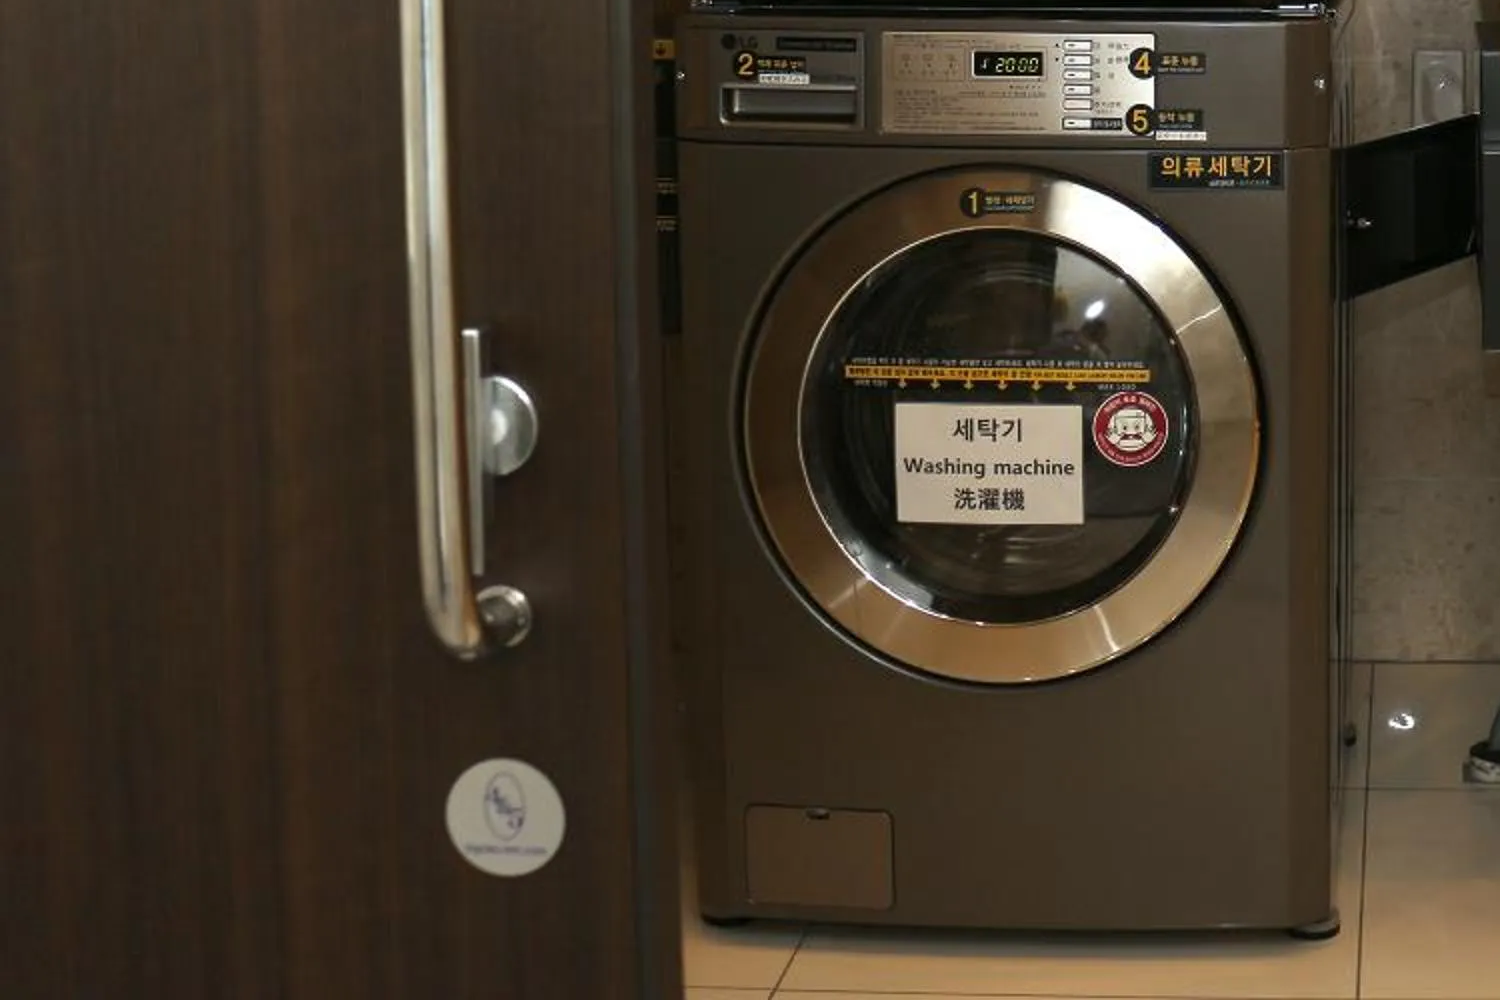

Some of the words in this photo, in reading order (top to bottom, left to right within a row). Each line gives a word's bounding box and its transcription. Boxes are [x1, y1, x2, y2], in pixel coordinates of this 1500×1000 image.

[738, 53, 754, 75] 2
[1134, 52, 1151, 74] 4
[1132, 110, 1148, 132] 5
[1161, 155, 1272, 178] 의류세탁기
[968, 192, 978, 214] 1
[953, 417, 1023, 442] 세탁기
[903, 457, 986, 479] Washing
[993, 458, 1075, 476] machine
[954, 487, 1025, 511] 洗濯機
